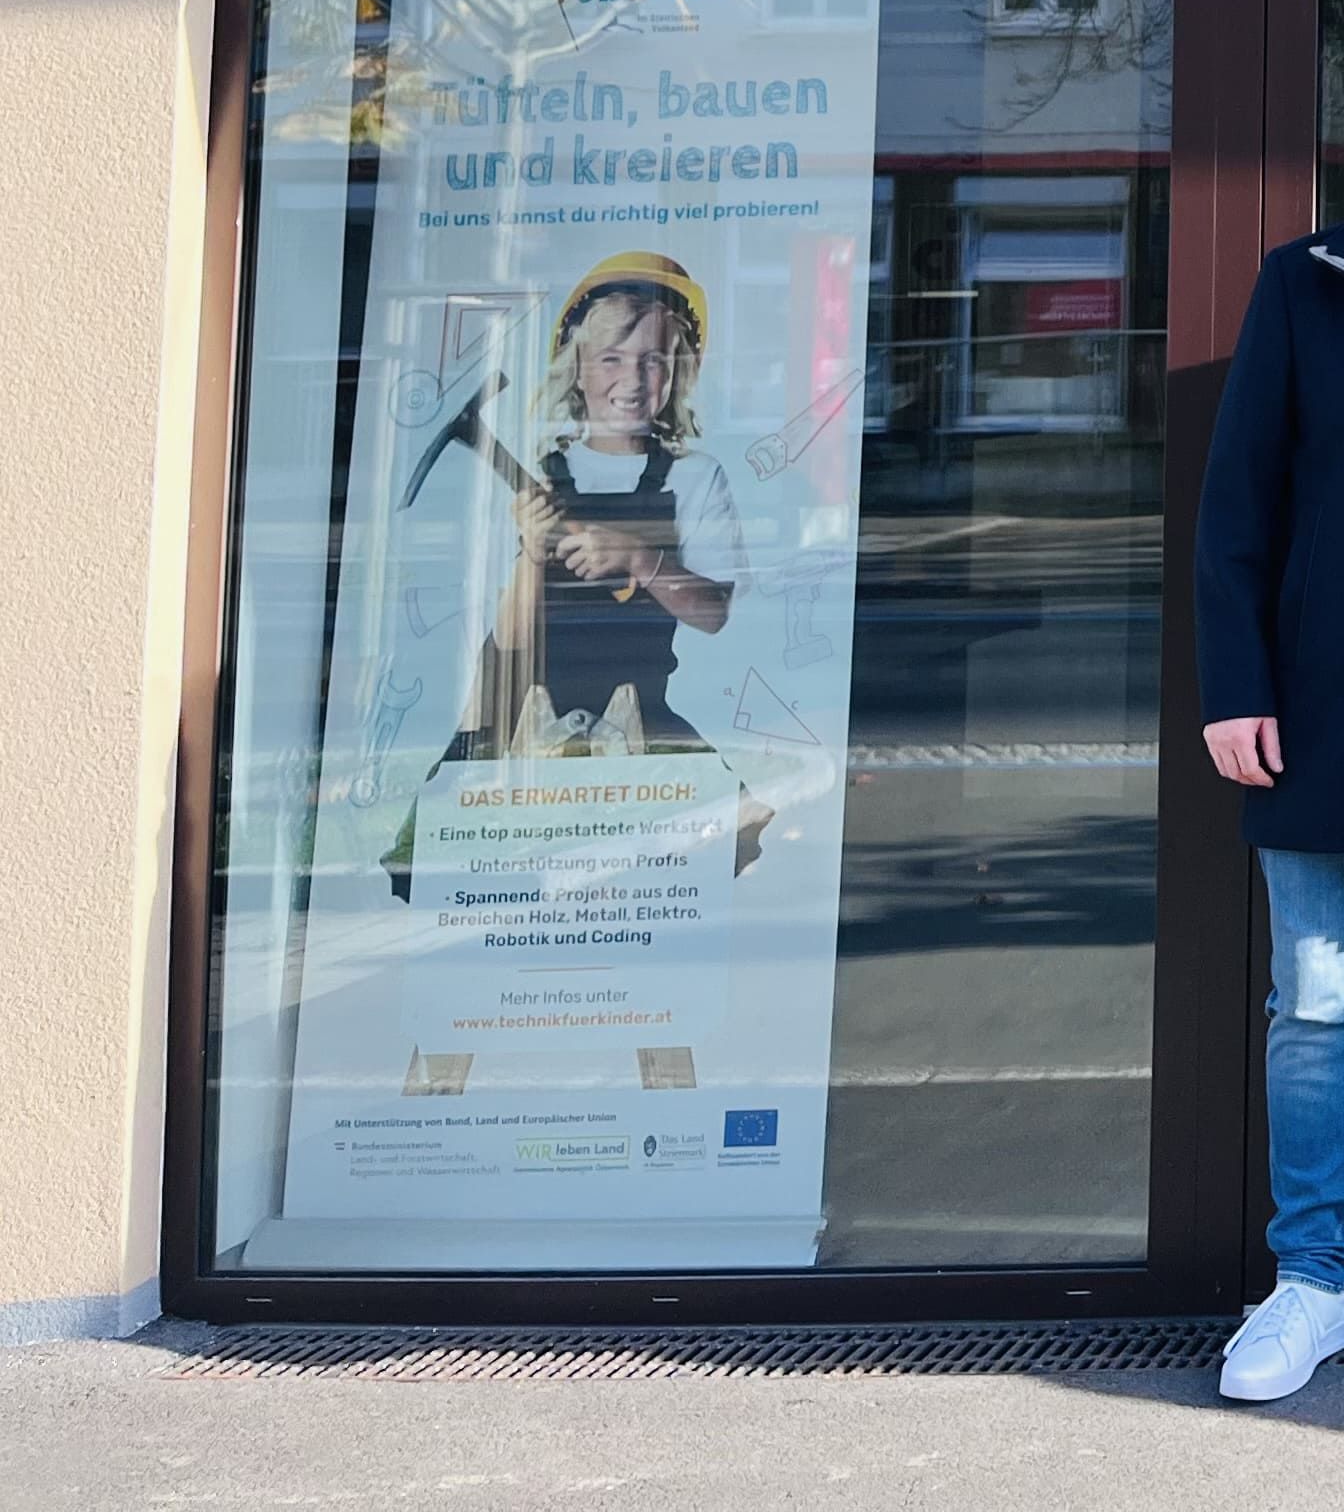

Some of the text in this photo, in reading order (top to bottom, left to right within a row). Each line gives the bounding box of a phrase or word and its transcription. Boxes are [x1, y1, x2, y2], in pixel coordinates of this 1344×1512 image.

[432, 70, 829, 128] Tüfteln, bauen
[446, 132, 799, 191] und kreieren
[418, 200, 820, 229] Bei uns kannst du richtig viel probieren!
[460, 783, 698, 809] DAS ERWARTET DICH:
[439, 826, 476, 842] Eine
[481, 827, 508, 843] top
[513, 822, 634, 841] ausgestattete
[470, 852, 688, 874] Unterstützung von Profis
[455, 884, 699, 906] Spannende Projekte aus den
[437, 905, 702, 927] Bereichen Holz, Metall, Elektro,
[484, 929, 653, 948] Robotik und Coding
[500, 988, 629, 1006] Mehr Infos unter
[452, 1008, 673, 1029] www.technikfuerkinder.at
[335, 1119, 351, 1129] Mit
[424, 1118, 443, 1127] von
[475, 1115, 499, 1126] Land
[501, 1115, 520, 1126] und
[555, 1143, 591, 1156] leben
[594, 1141, 625, 1155] Land
